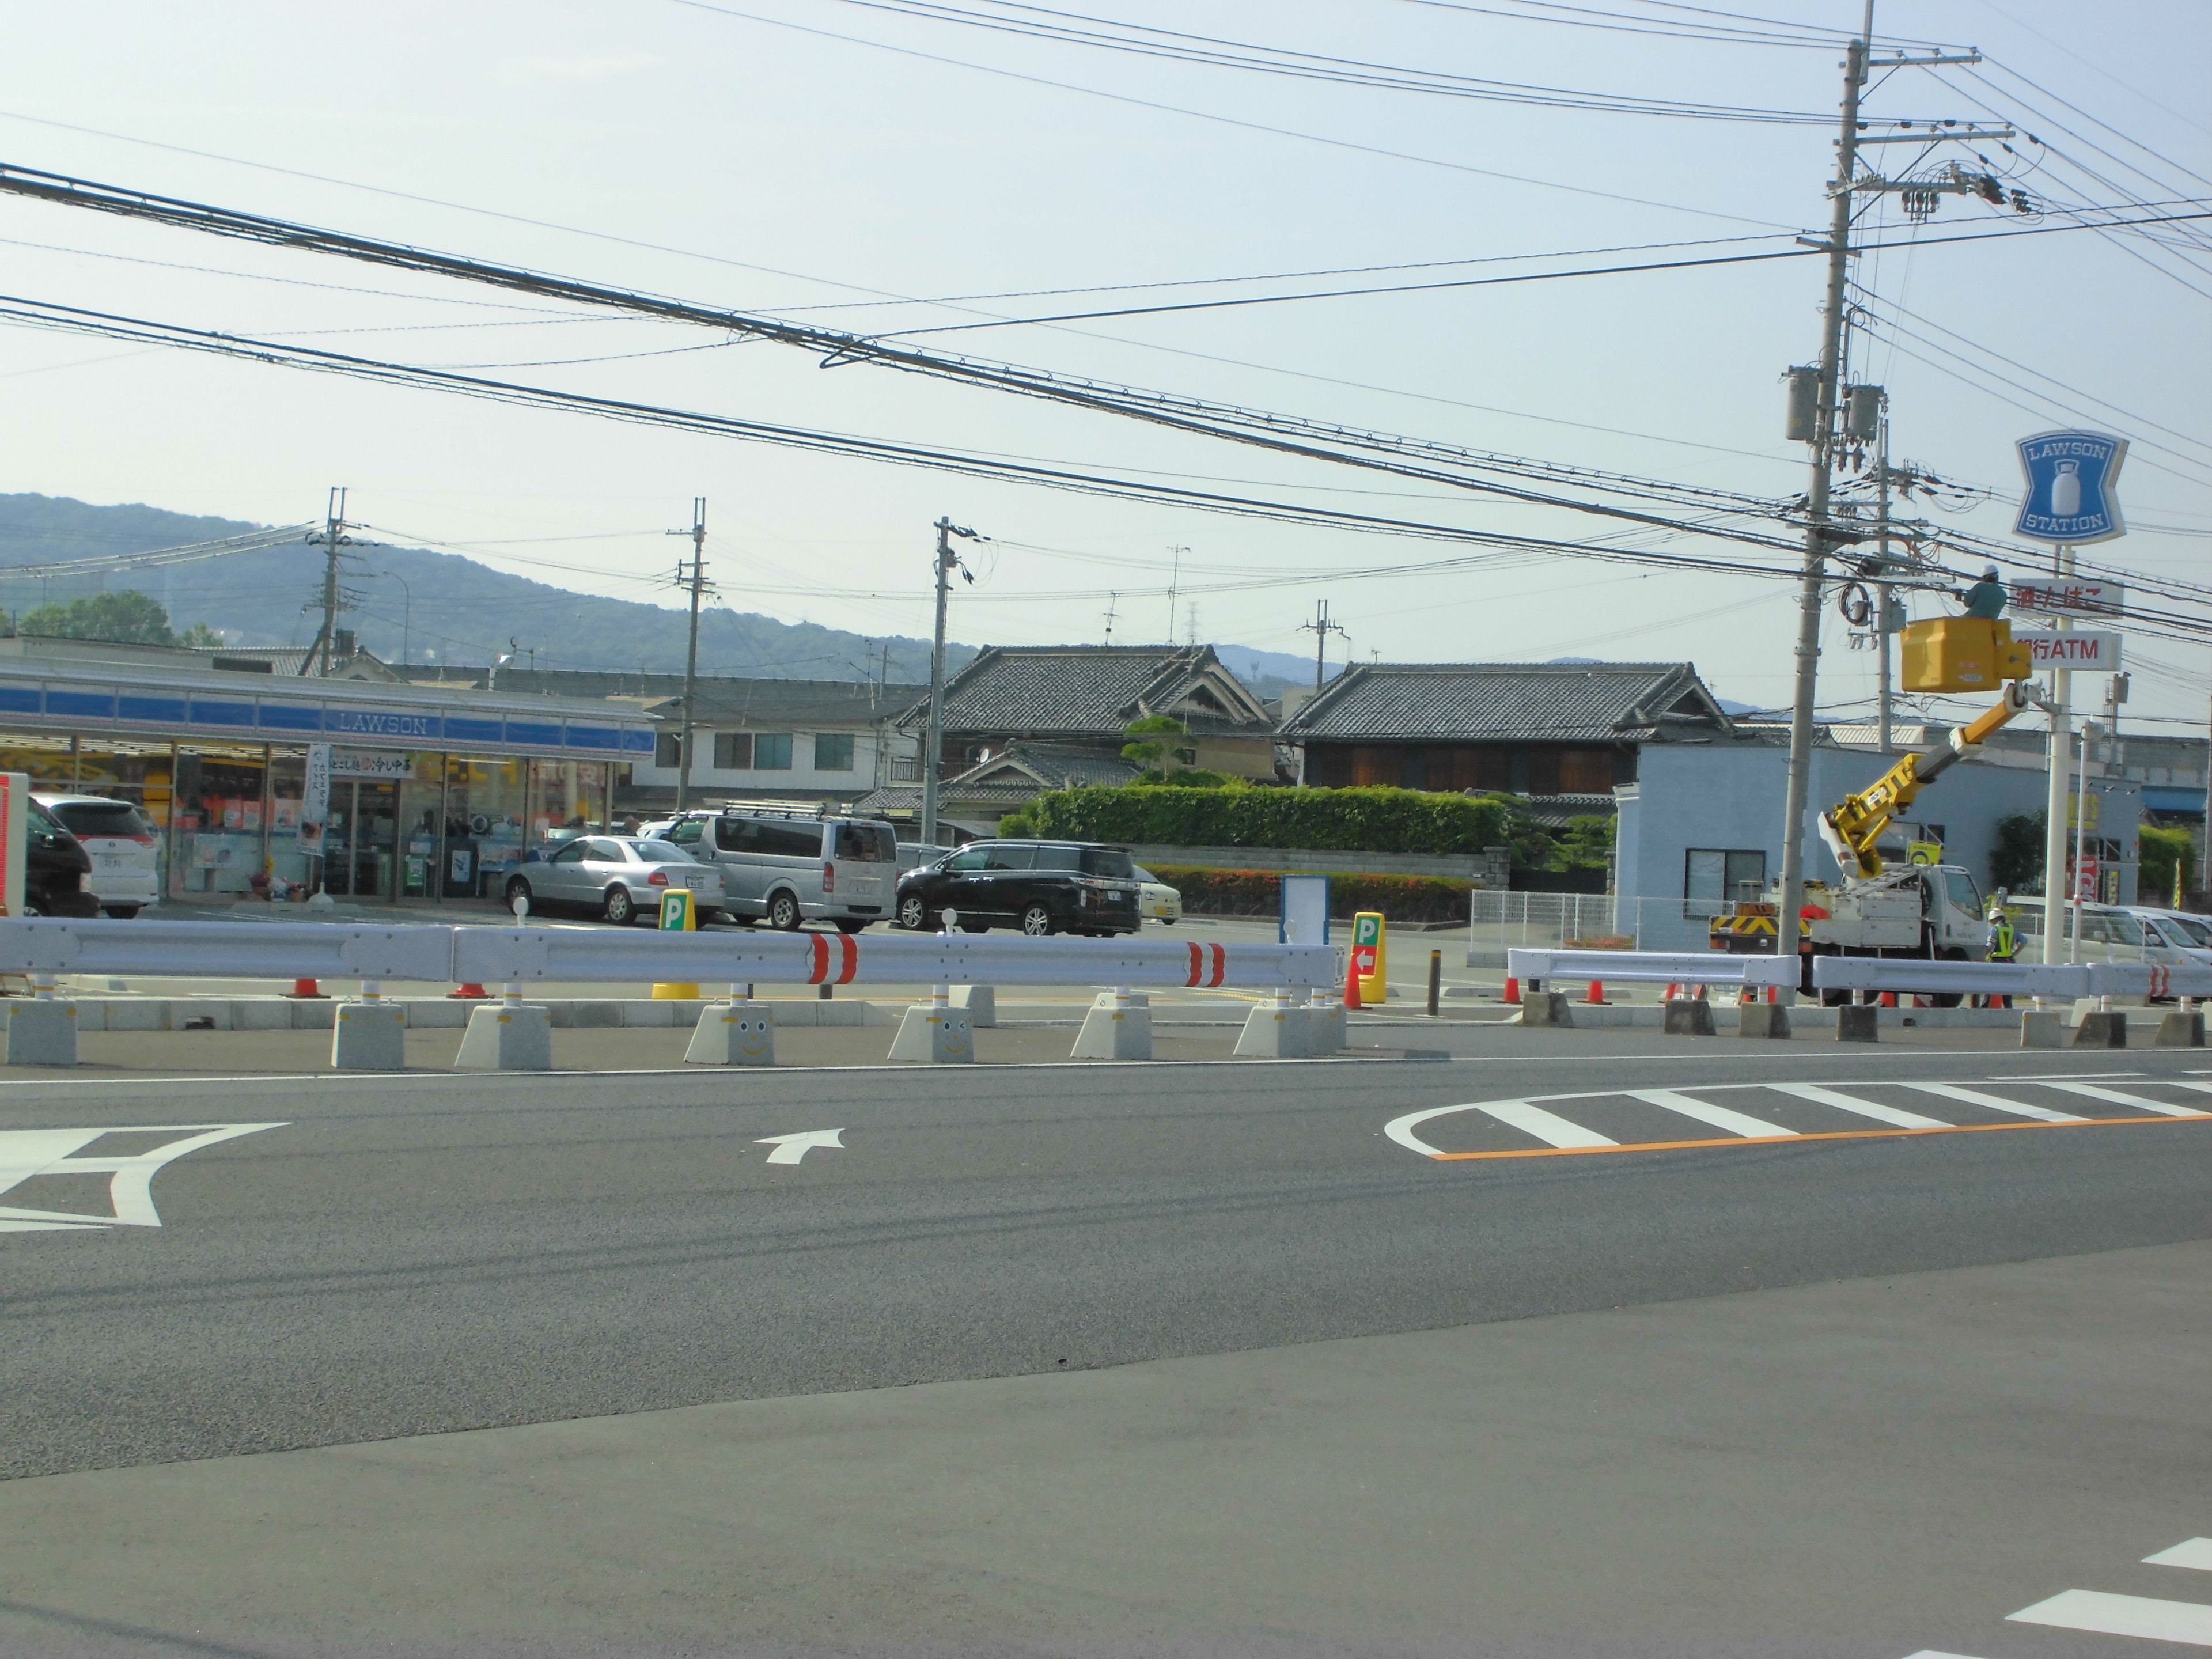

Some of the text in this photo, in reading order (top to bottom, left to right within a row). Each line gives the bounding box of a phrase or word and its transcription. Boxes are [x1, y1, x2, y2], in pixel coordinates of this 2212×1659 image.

[2028, 442, 2107, 460] LAWSON
[2026, 514, 2104, 531] STATION
[340, 713, 427, 734] LAWSON
[665, 898, 682, 927] P
[1359, 919, 1376, 943] P
